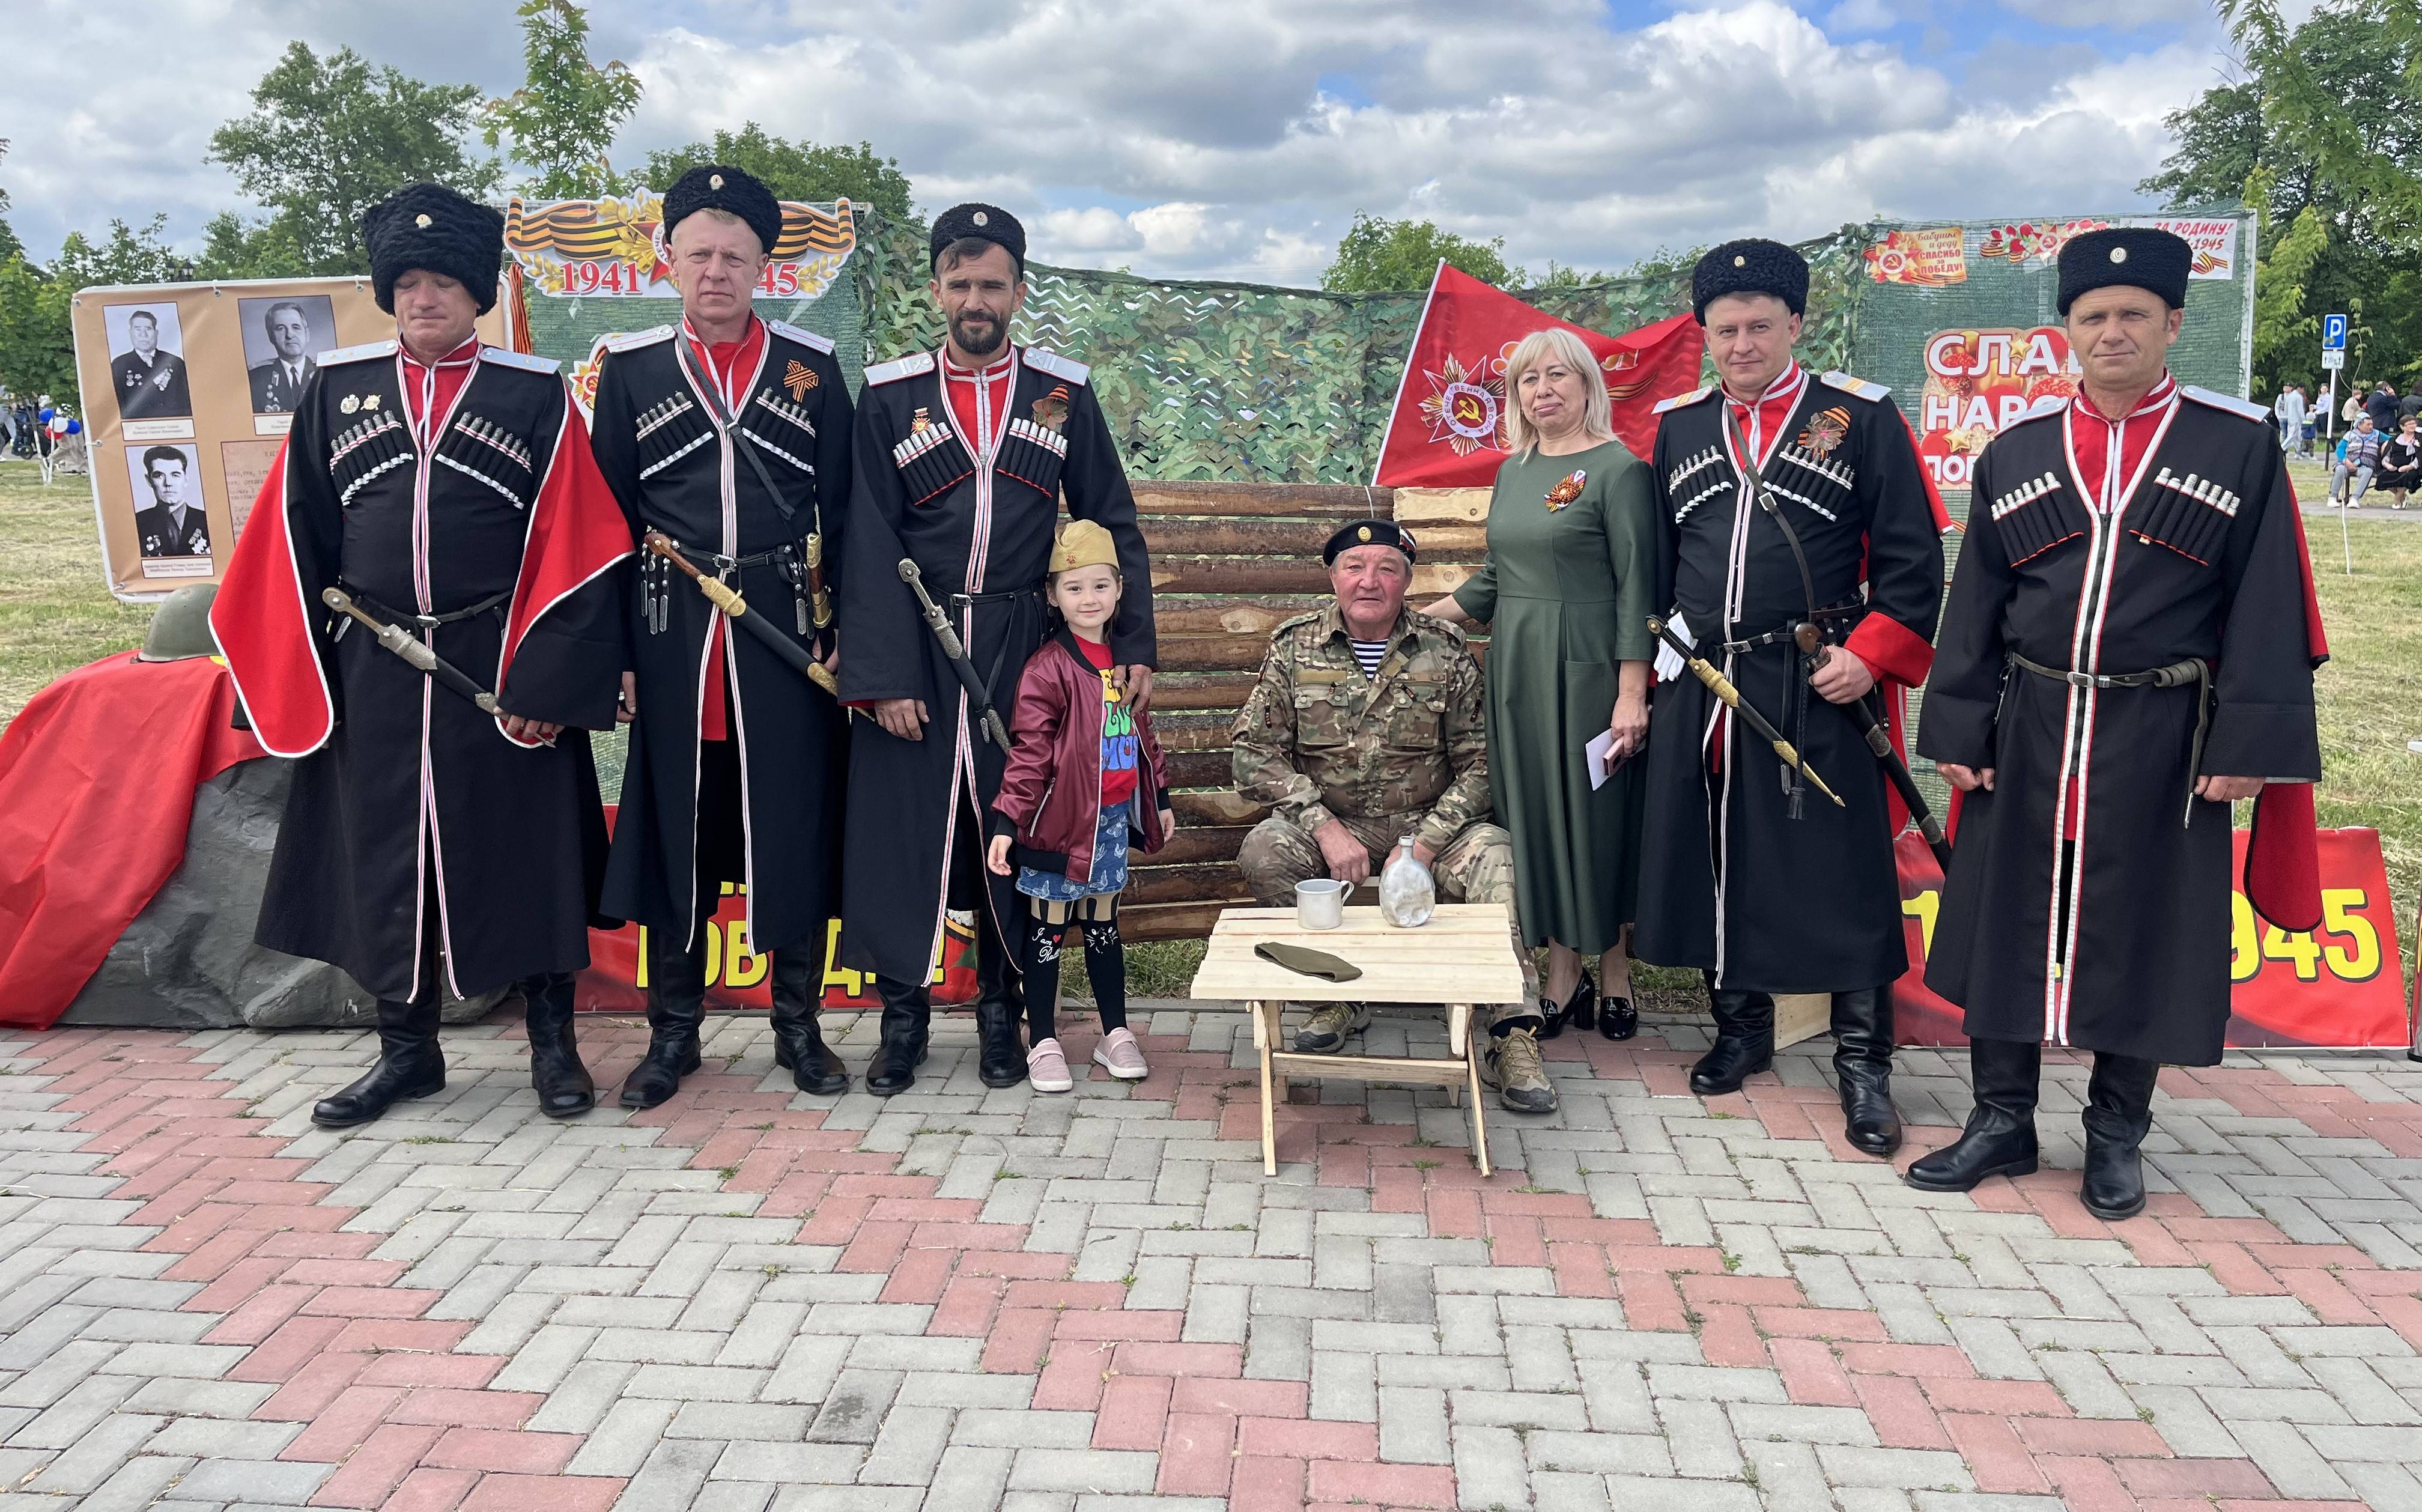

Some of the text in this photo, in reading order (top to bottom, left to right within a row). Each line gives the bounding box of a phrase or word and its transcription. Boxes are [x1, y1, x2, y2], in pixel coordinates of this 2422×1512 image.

[2173, 222, 2234, 235] РОДИНУ!
[1920, 249, 1961, 260] СПАСИБО
[1920, 263, 1962, 274] ПОБЕДУ!
[560, 261, 799, 294] 1941 45
[2329, 318, 2342, 345] P
